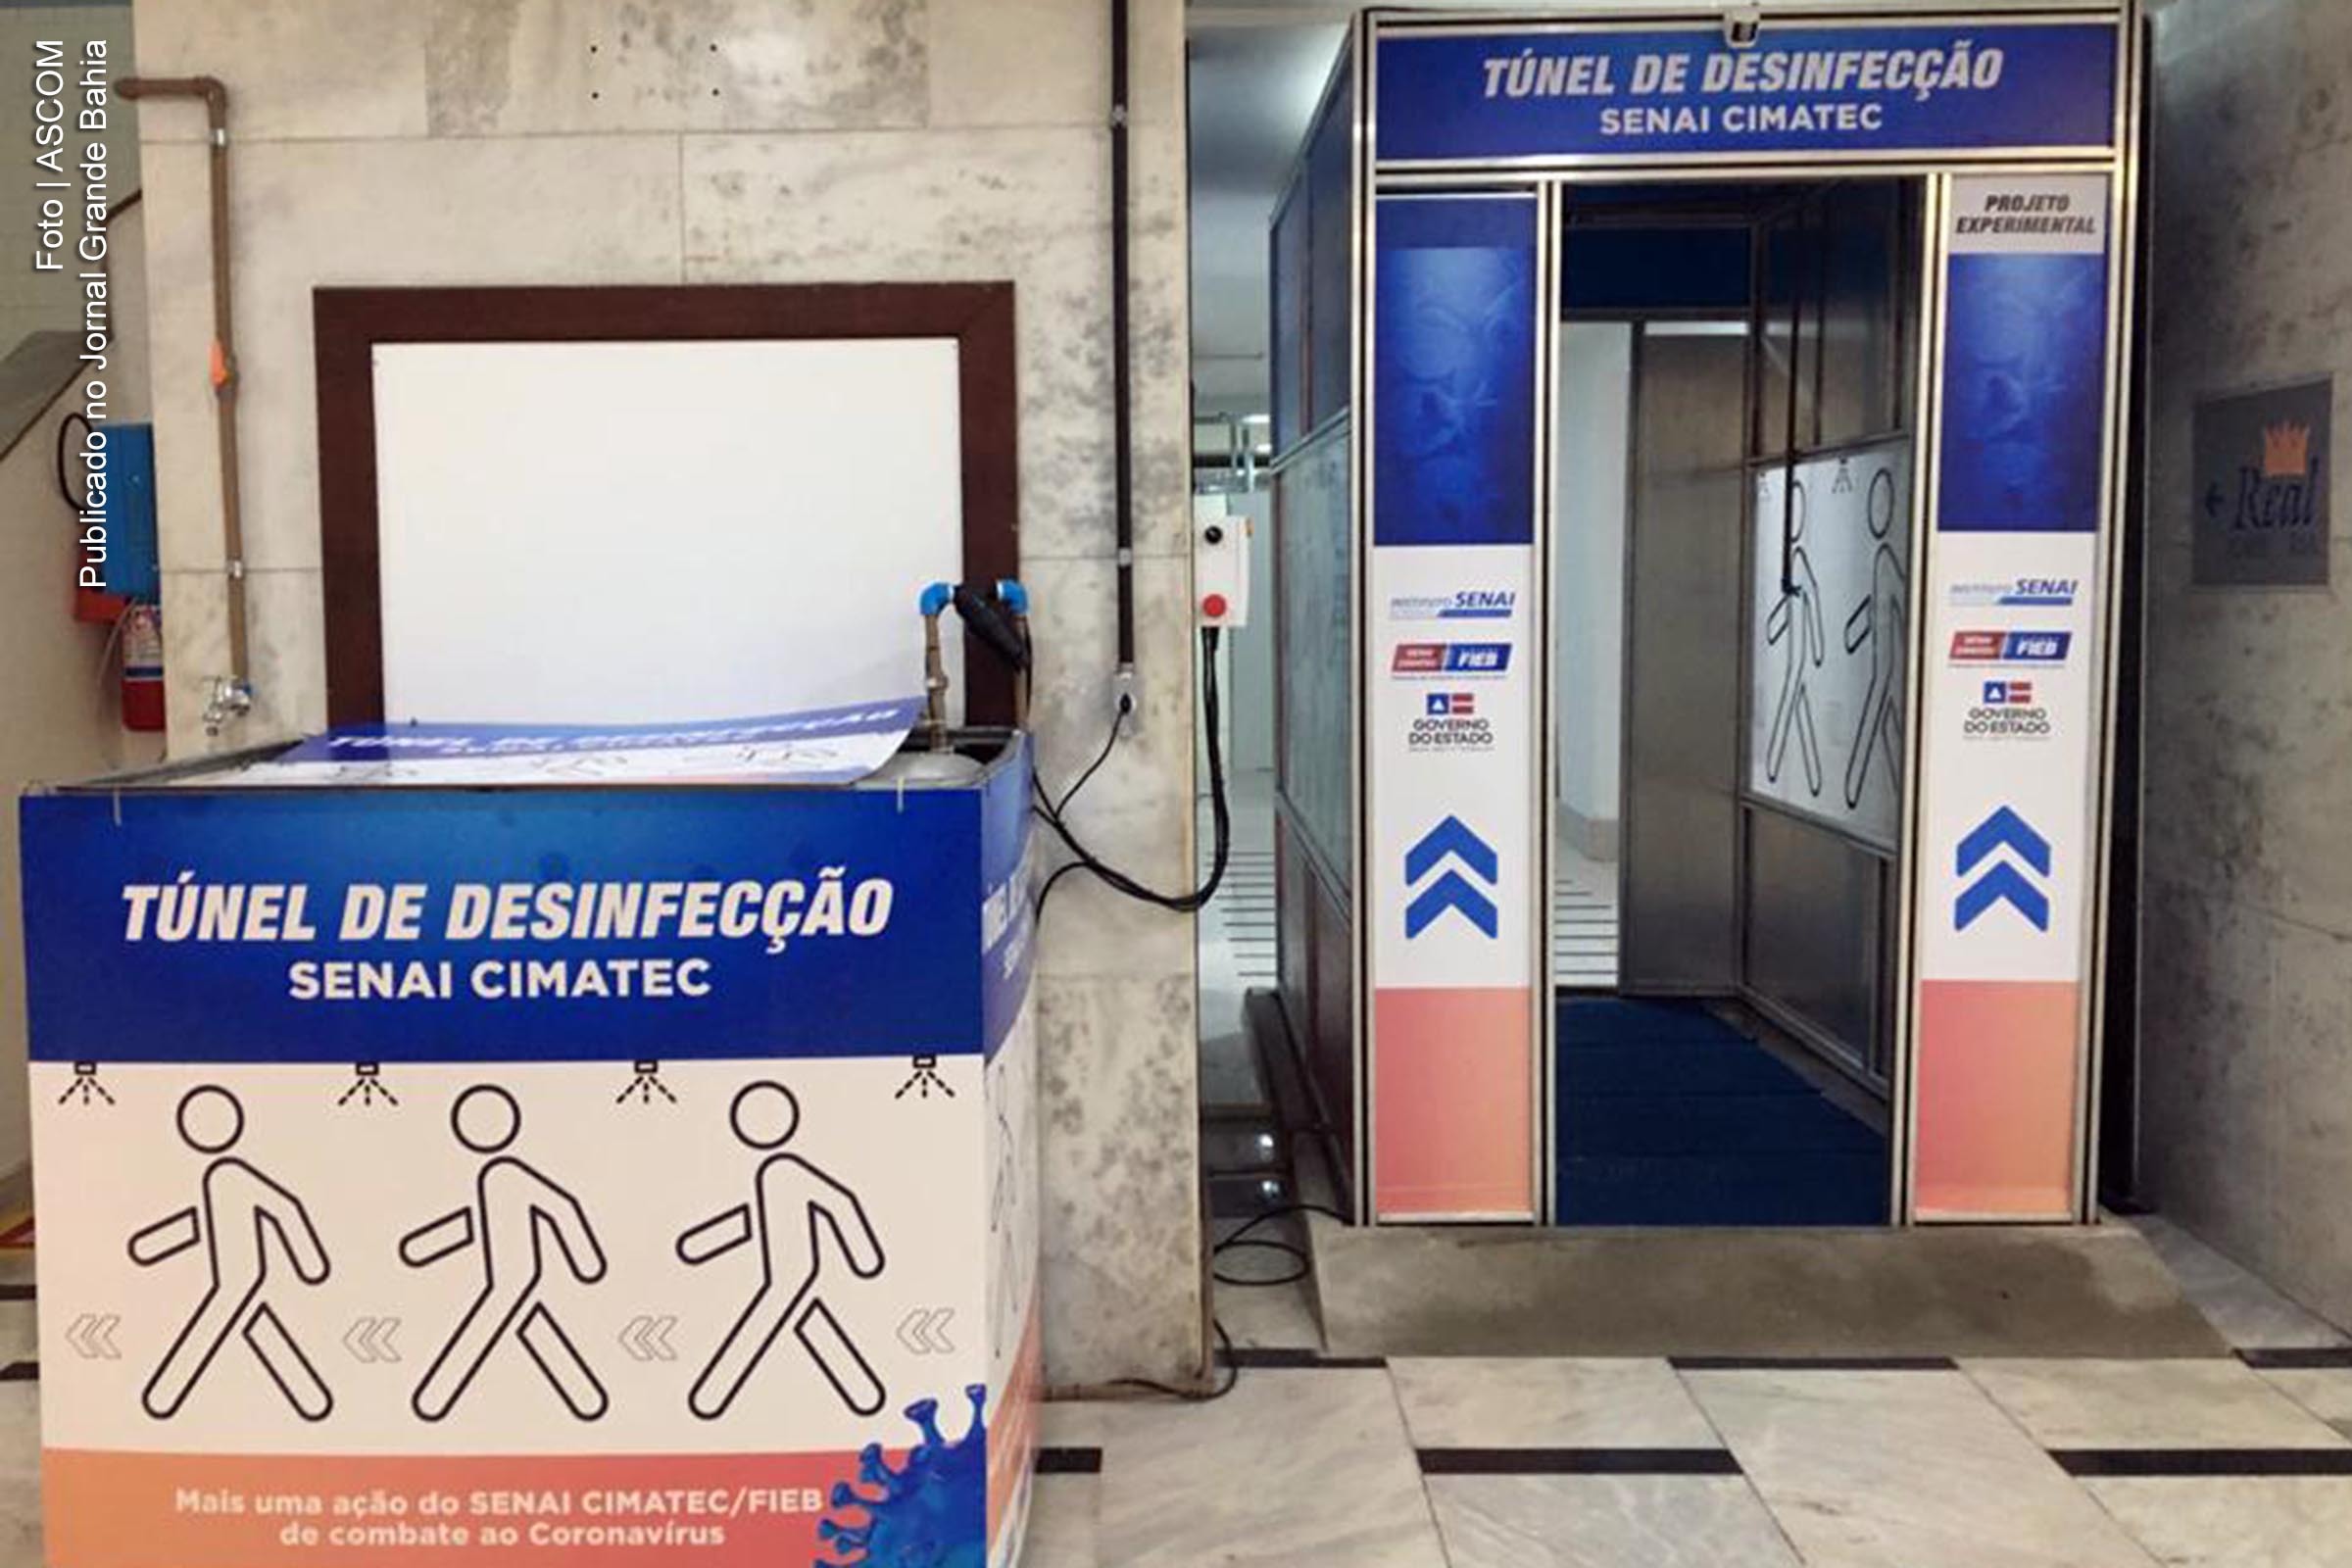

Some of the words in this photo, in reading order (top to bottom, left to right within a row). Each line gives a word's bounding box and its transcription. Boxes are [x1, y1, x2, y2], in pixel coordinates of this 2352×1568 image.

[1483, 48, 1615, 98] TÚNEL
[1630, 53, 1690, 94] DE
[1700, 38, 2005, 102] DESINFECÇÃO
[1599, 106, 1710, 134] SENAI
[1722, 103, 1883, 132] CIMATEC
[1984, 194, 2071, 212] PROJETO
[1955, 216, 2096, 233] EXPERIMENTAL
[2015, 579, 2079, 595] SENAI
[1455, 591, 1516, 608] SENAI
[1969, 708, 2047, 720] GOVERNO
[1412, 718, 1490, 732] GOVERNO
[1964, 721, 1988, 734] DO
[1989, 721, 2051, 734] ESTADO
[1408, 732, 1433, 745] DO
[1434, 732, 1494, 745] ESTADO
[122, 870, 318, 943] TÚNEL
[338, 883, 429, 942] DE
[444, 865, 895, 956] DESINFECÇÃO
[288, 960, 454, 1002] SENAI
[469, 957, 712, 1000] CIMATEC
[174, 1489, 246, 1514] Mais
[254, 1493, 324, 1515] uma
[332, 1491, 410, 1520] ação
[417, 1491, 461, 1515] do
[468, 1490, 571, 1515] SENAI
[580, 1487, 824, 1518] CIMATEC/FIEB
[278, 1522, 320, 1545] de
[328, 1522, 470, 1545] combate
[478, 1525, 519, 1545] ao
[528, 1520, 726, 1545] Coronavírus
